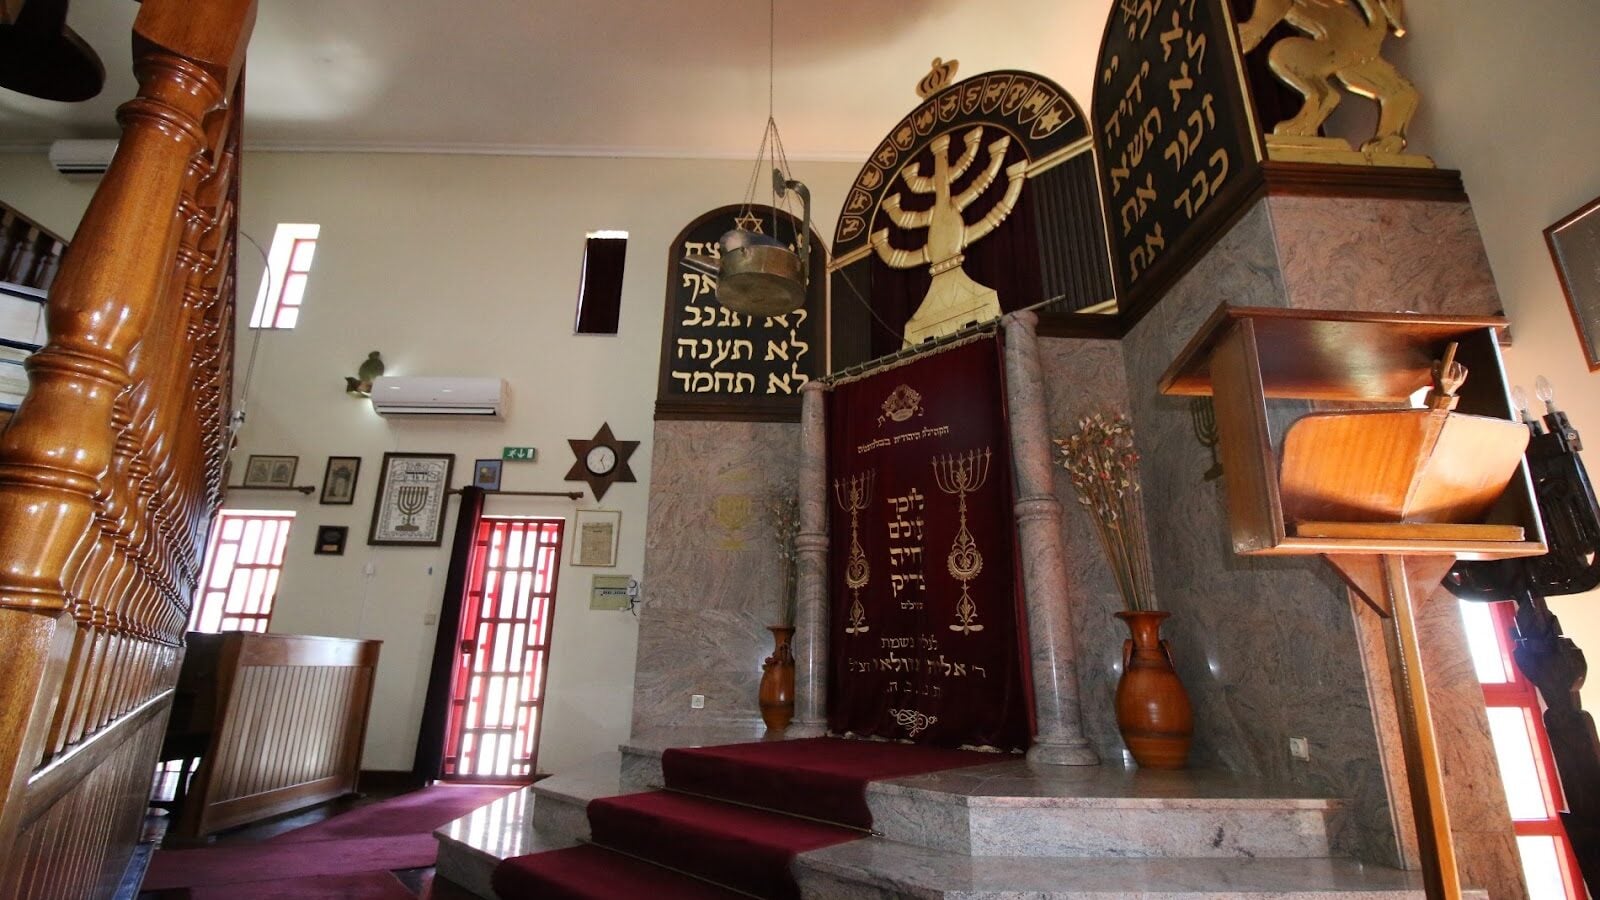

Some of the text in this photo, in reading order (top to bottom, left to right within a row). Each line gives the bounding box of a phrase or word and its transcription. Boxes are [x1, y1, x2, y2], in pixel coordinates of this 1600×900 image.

[1105, 60, 1149, 149] יהיה
[1111, 29, 1206, 196] לא תשא
[1121, 92, 1215, 237] זכור את
[1130, 148, 1229, 281] כבד את
[672, 362, 809, 394] לא תחמד
[677, 329, 809, 369] לא תענה
